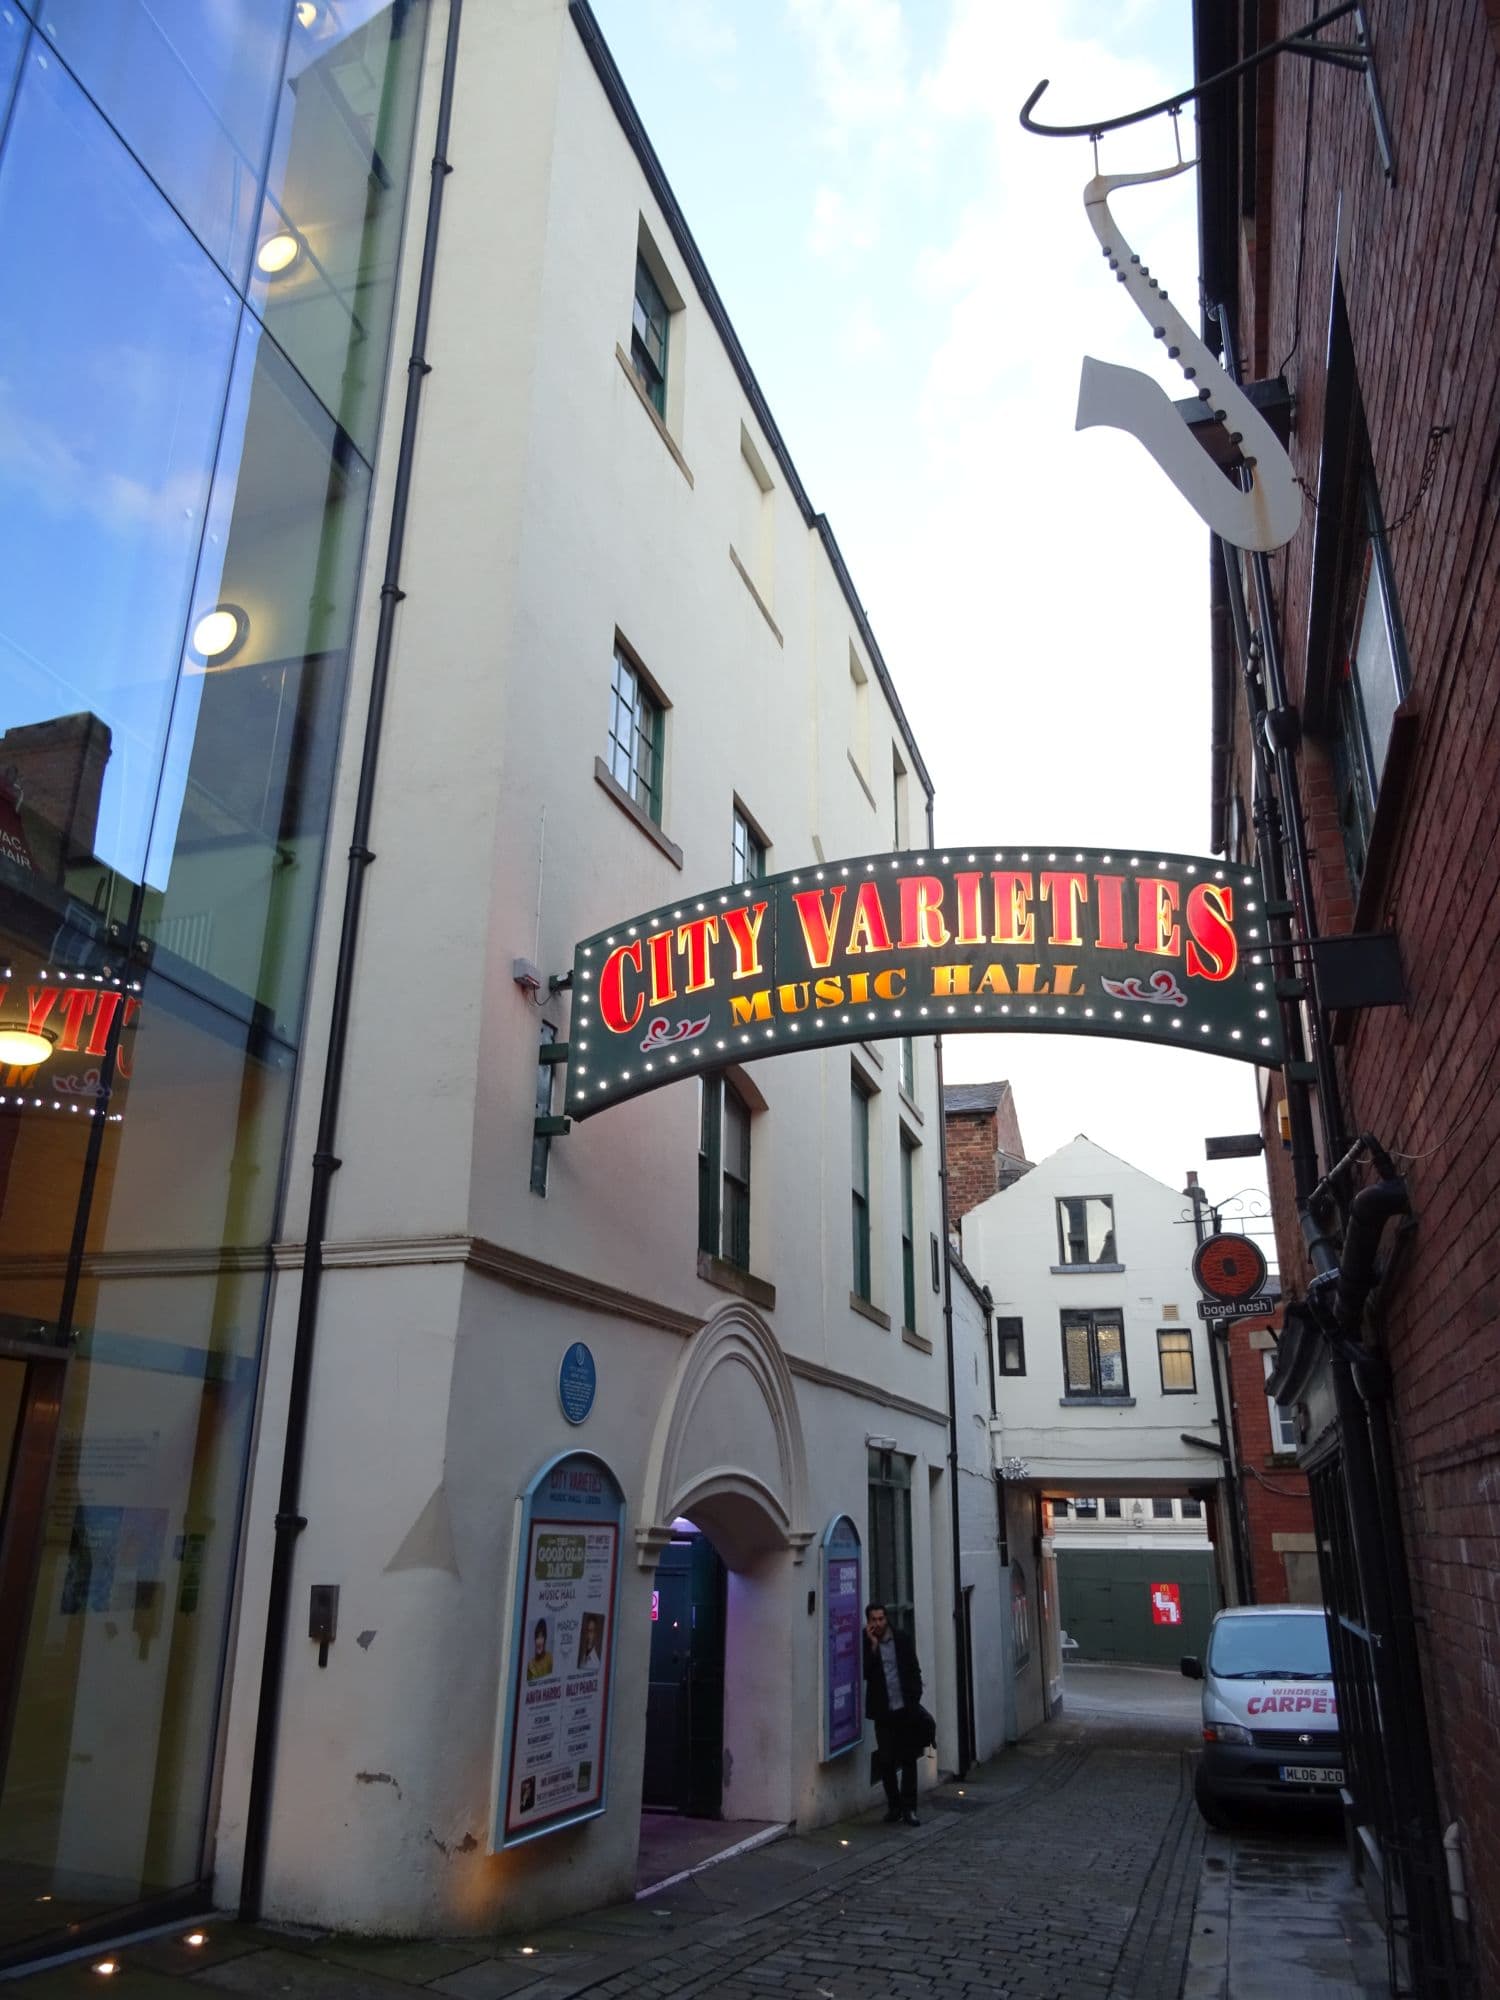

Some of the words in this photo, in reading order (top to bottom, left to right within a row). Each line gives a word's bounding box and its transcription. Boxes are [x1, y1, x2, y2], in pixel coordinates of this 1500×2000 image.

[599, 902, 769, 1034] CITY
[792, 871, 1238, 982] VARIETIES
[730, 968, 907, 1028] MUSIC
[931, 964, 1086, 998] HALL
[1204, 1302, 1235, 1316] bagel
[1240, 1301, 1267, 1312] nash
[538, 1546, 564, 1562] GOOD
[538, 1588, 560, 1601] MUSIC
[1272, 1687, 1328, 1697] WINDERS
